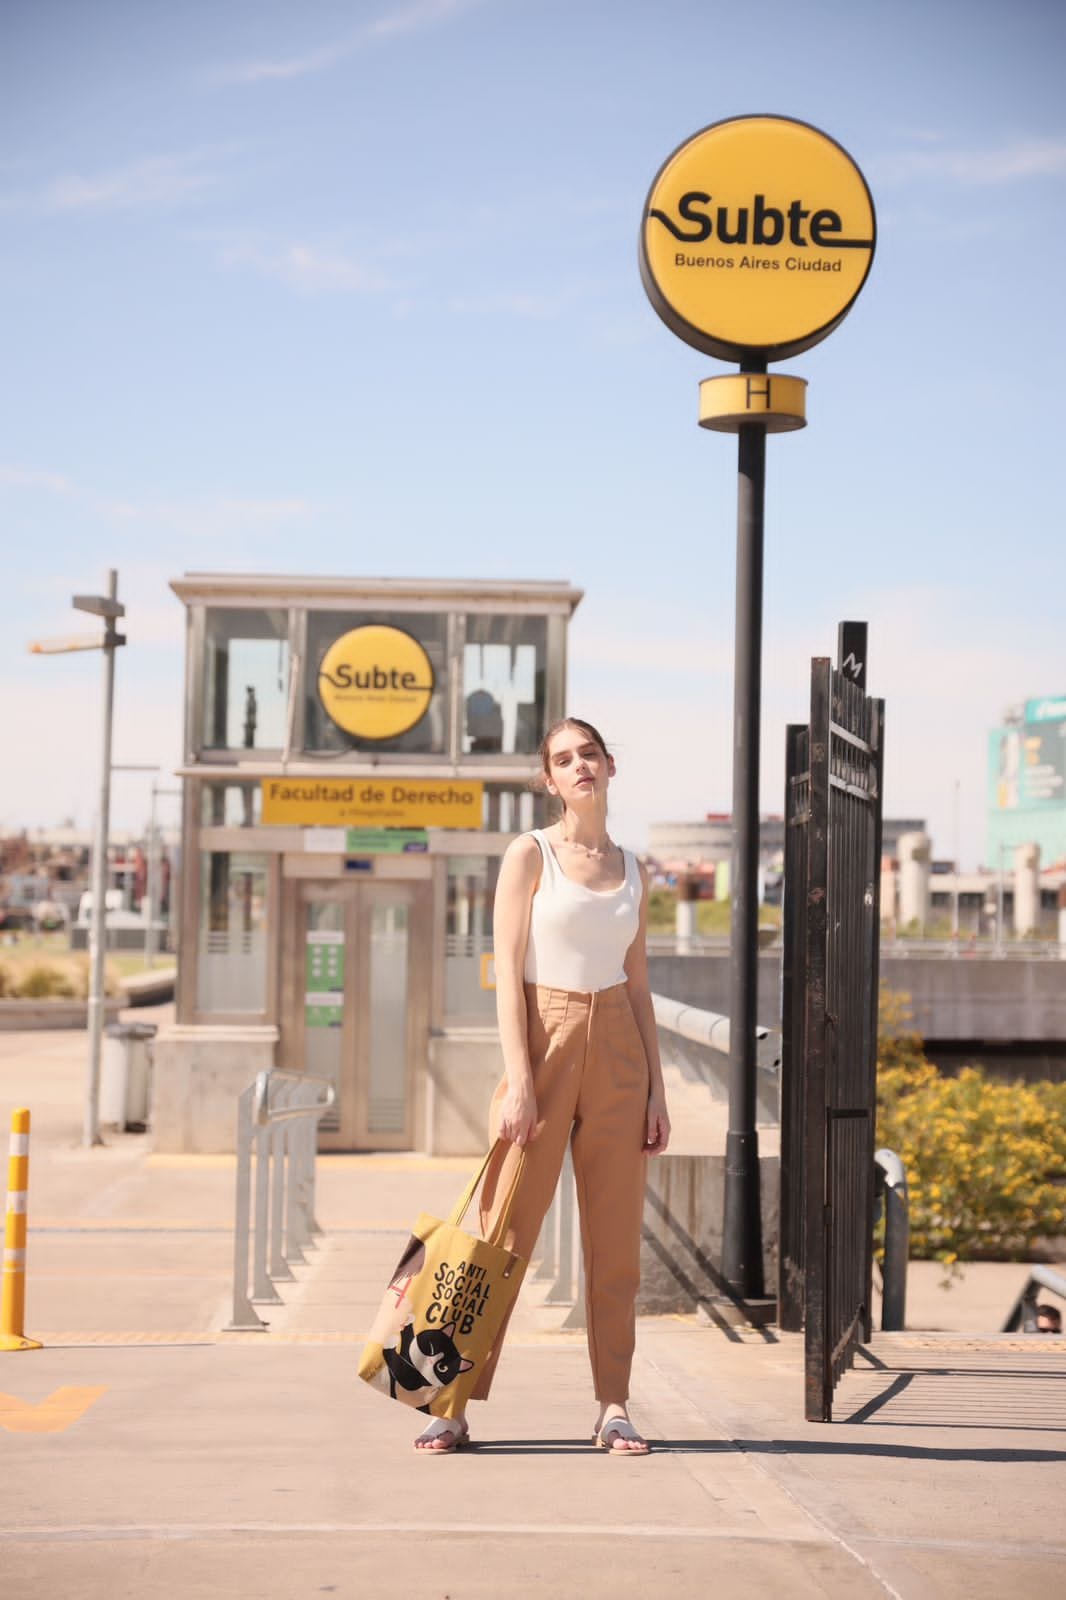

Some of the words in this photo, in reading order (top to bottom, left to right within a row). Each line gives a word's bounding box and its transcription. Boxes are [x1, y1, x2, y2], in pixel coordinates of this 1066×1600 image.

[656, 191, 870, 249] Subte
[674, 253, 734, 268] Buenos
[739, 256, 780, 270] Aires
[785, 257, 842, 272] Ciudad
[745, 377, 771, 410] H
[325, 664, 428, 691] Subte
[270, 784, 354, 802] Facultad
[360, 787, 385, 803] de
[391, 788, 474, 805] Derecho
[434, 1262, 490, 1299] SOCIAL
[457, 1261, 487, 1281] ANTI
[432, 1283, 486, 1317] SOCIAL
[425, 1302, 475, 1335] CLUB
